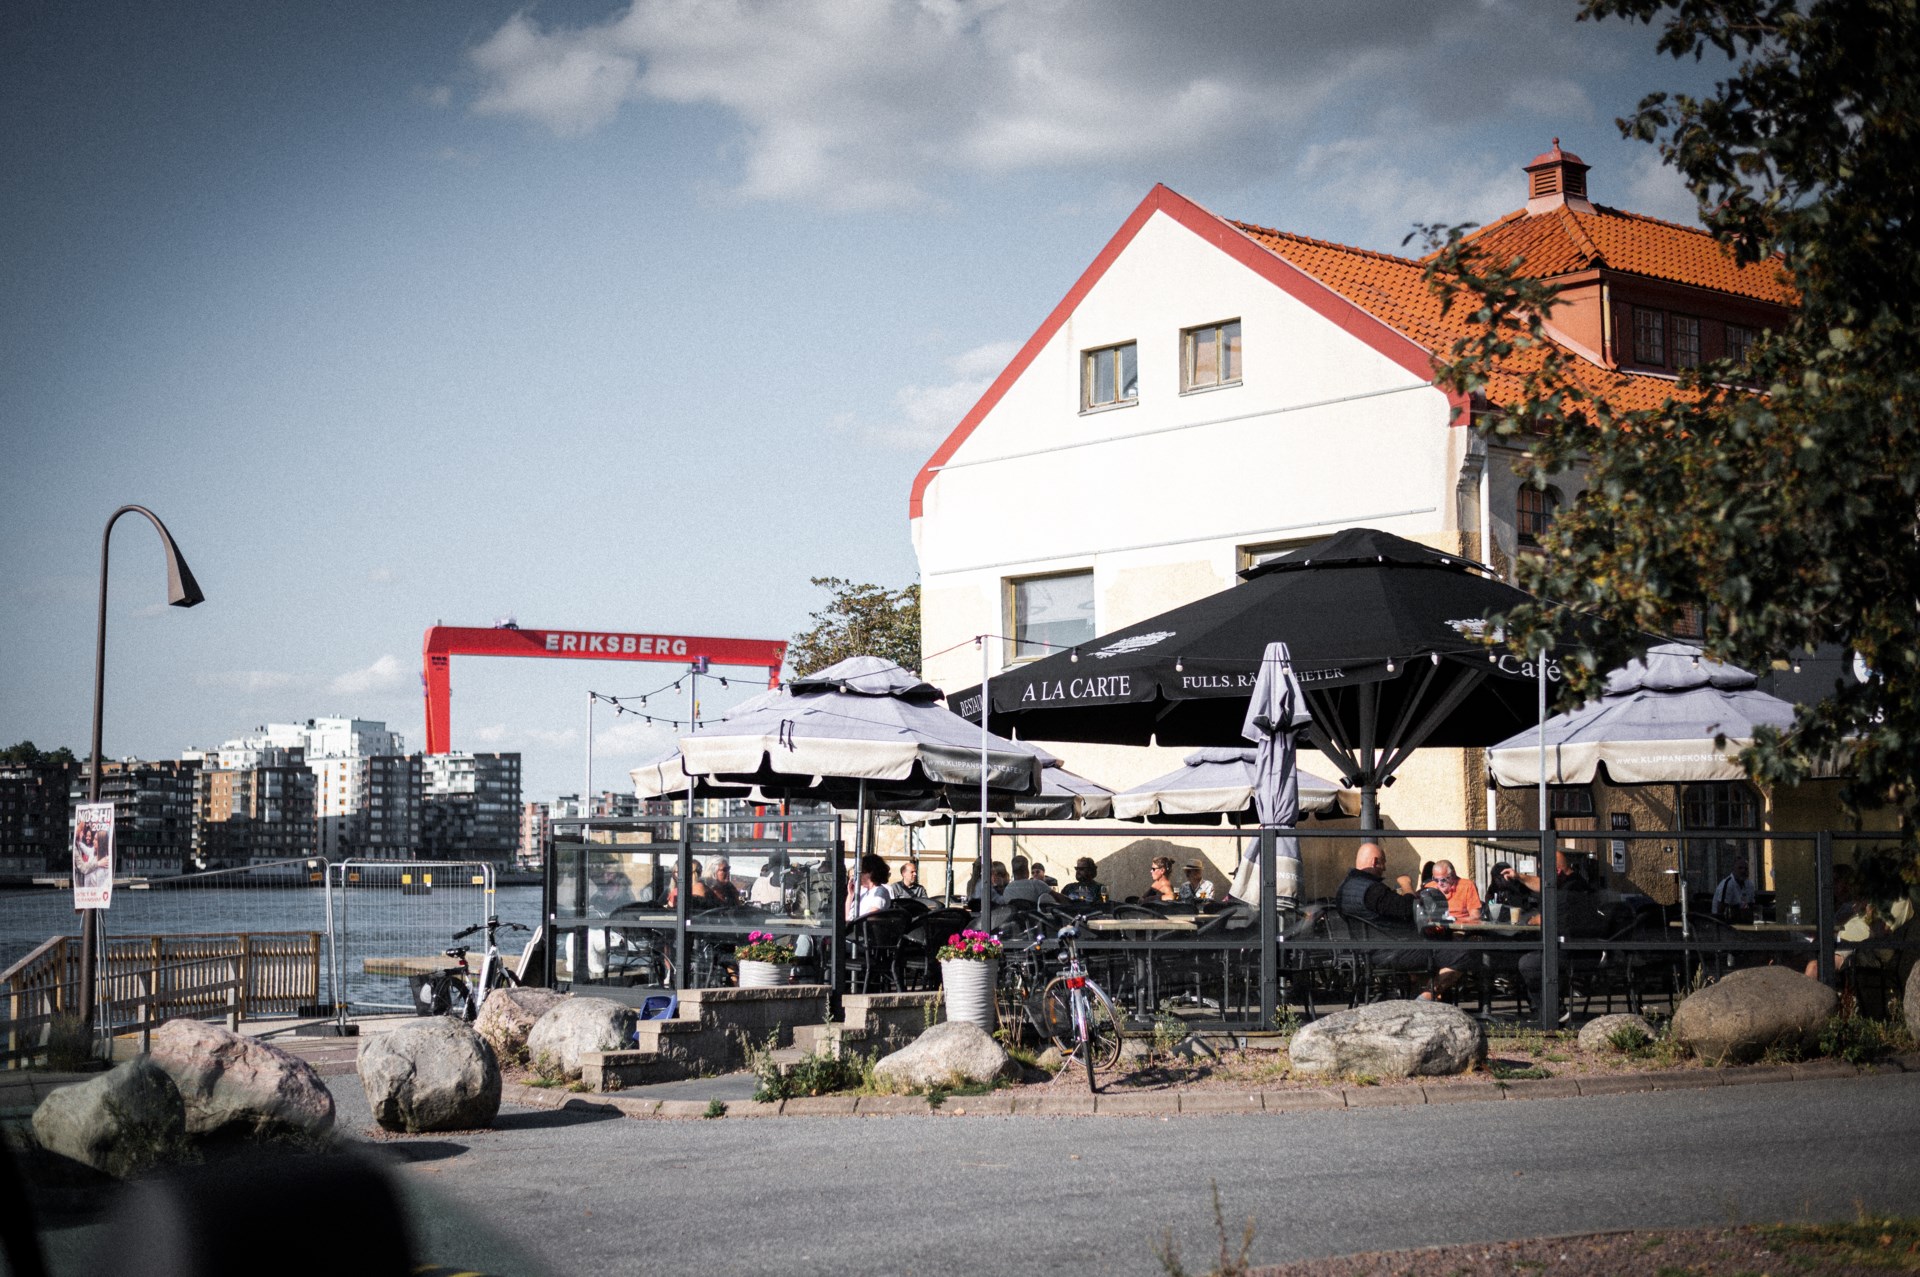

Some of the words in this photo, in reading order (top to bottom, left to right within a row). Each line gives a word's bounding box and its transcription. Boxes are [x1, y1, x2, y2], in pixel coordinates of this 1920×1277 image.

[546, 634, 688, 655] ERIKSBERG
[1022, 682, 1037, 702] A
[1041, 680, 1066, 701] LA
[1069, 675, 1132, 699] CARTE
[1182, 675, 1234, 689] FULLS.
[1237, 667, 1345, 687] RÄHETER
[959, 694, 983, 718] RESTAU
